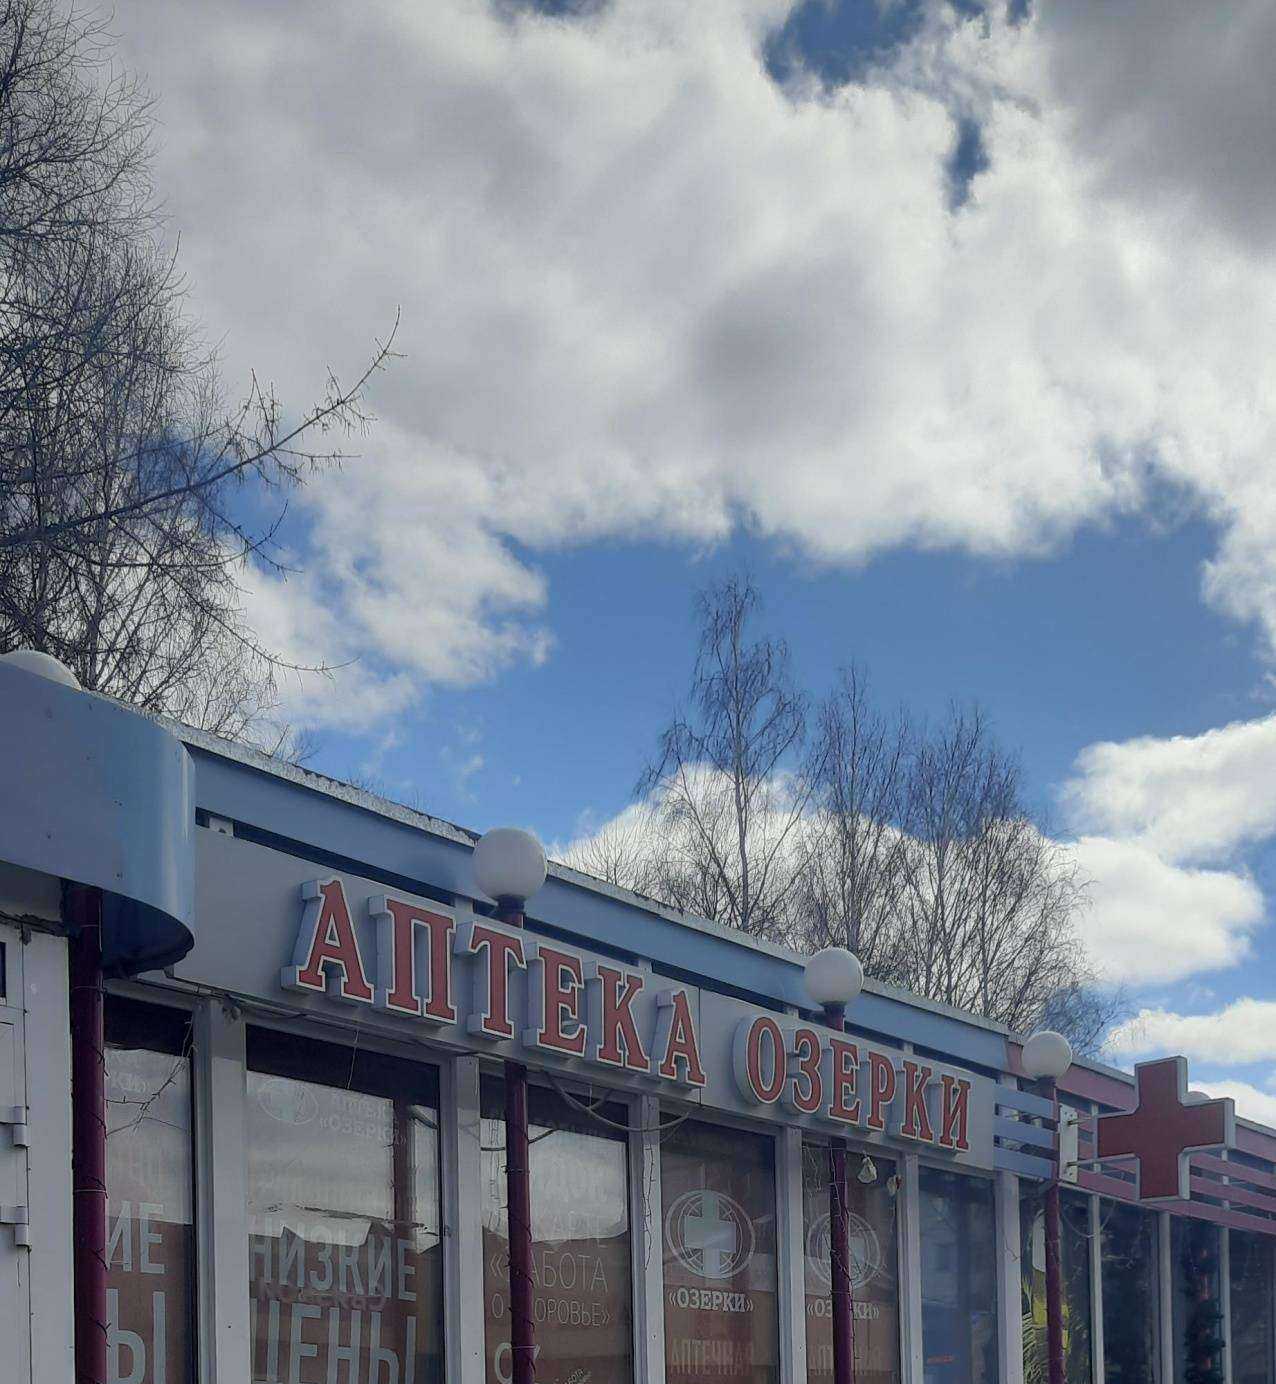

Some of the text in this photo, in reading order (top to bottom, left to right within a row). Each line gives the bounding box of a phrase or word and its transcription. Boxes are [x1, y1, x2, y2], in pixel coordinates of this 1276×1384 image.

[297, 878, 971, 1151] АПТЕКА ОЗЕРКИ
[248, 1214, 417, 1302] НИЗКИЕ
[668, 1287, 754, 1313] «ОЗЕРКИ»
